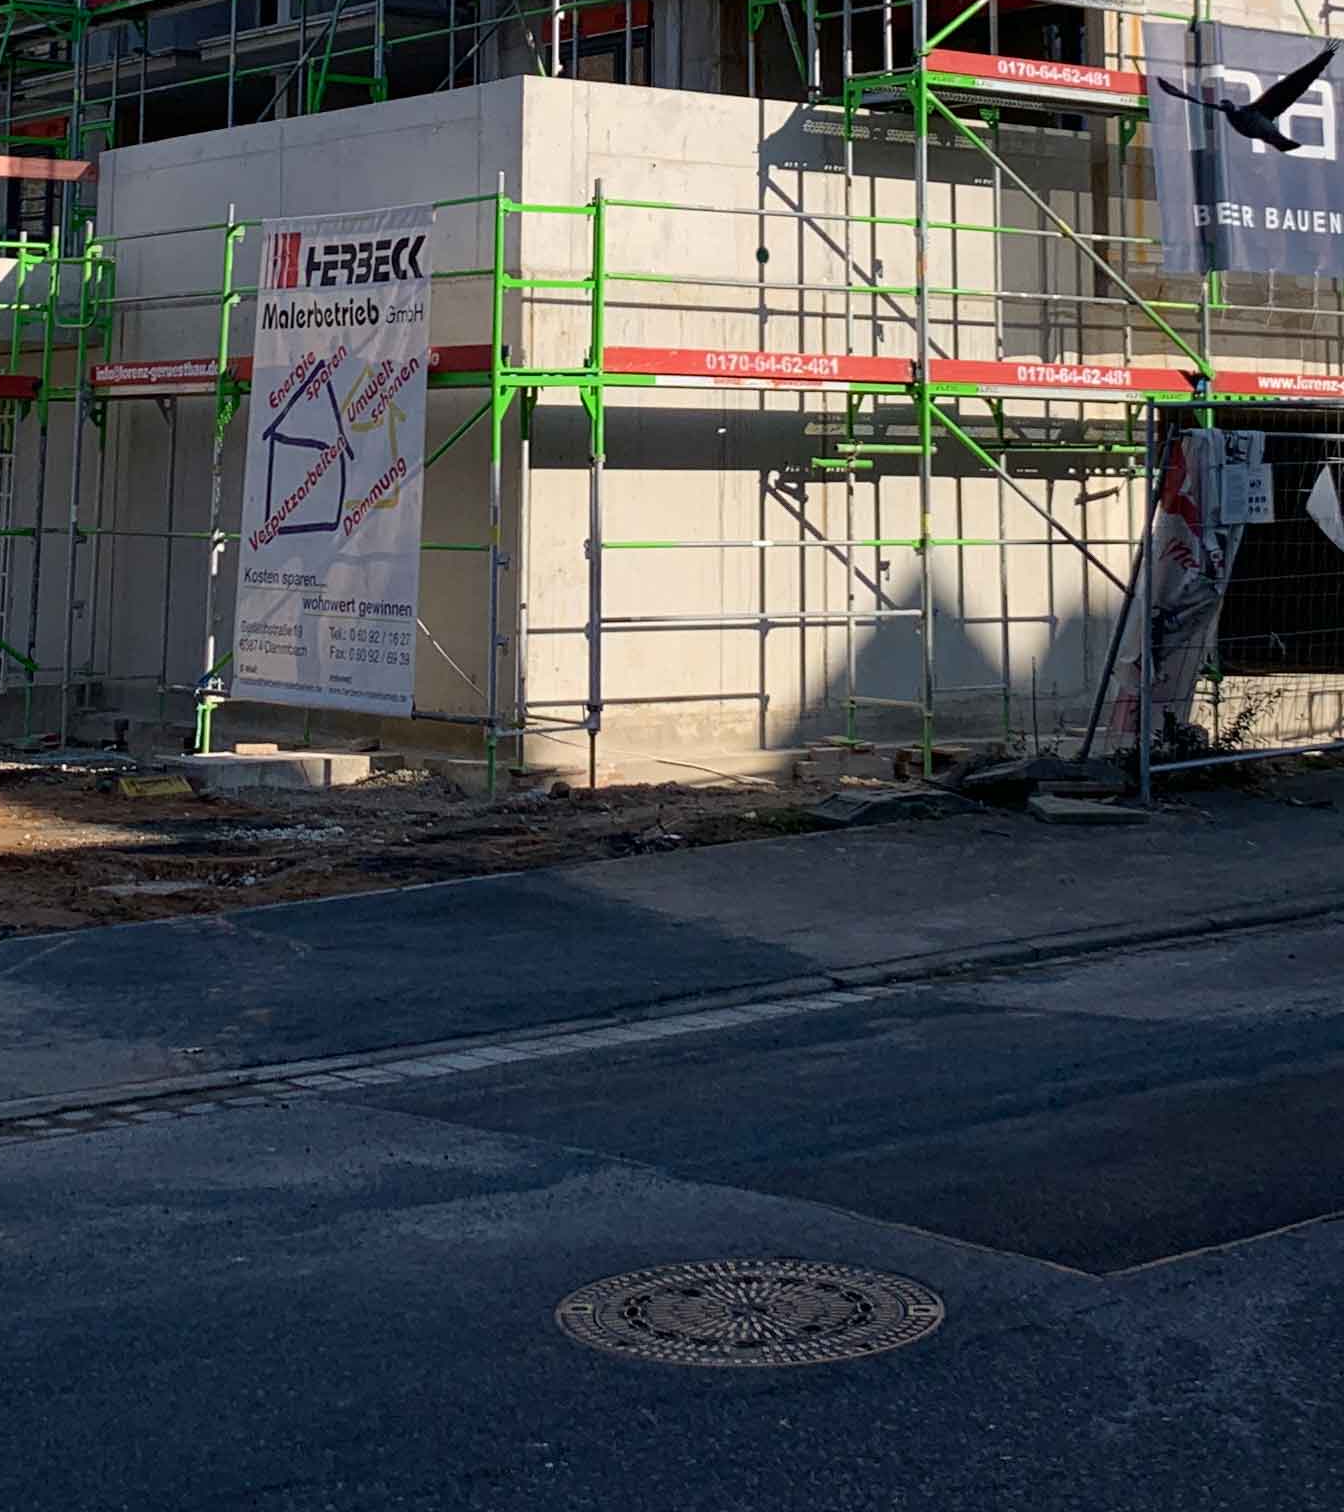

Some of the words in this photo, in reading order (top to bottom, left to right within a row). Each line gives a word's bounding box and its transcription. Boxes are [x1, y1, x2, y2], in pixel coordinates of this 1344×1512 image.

[998, 59, 1111, 88] 0170-64-62-481
[305, 235, 426, 287] HERBECK
[262, 297, 380, 331] Malerbetrieb
[385, 303, 425, 324] GmbH
[268, 350, 317, 410] Energie
[305, 344, 348, 402] sparen
[370, 356, 420, 423] schonen
[706, 353, 839, 376] 0170-64-62-481
[1017, 364, 1133, 387] 0170-64-62-481
[347, 359, 395, 423] Umwelt
[248, 433, 346, 552] Verputzarbeiten
[343, 455, 408, 537] Dämmung
[244, 568, 280, 585] Kosten
[358, 600, 412, 617] gewinnen
